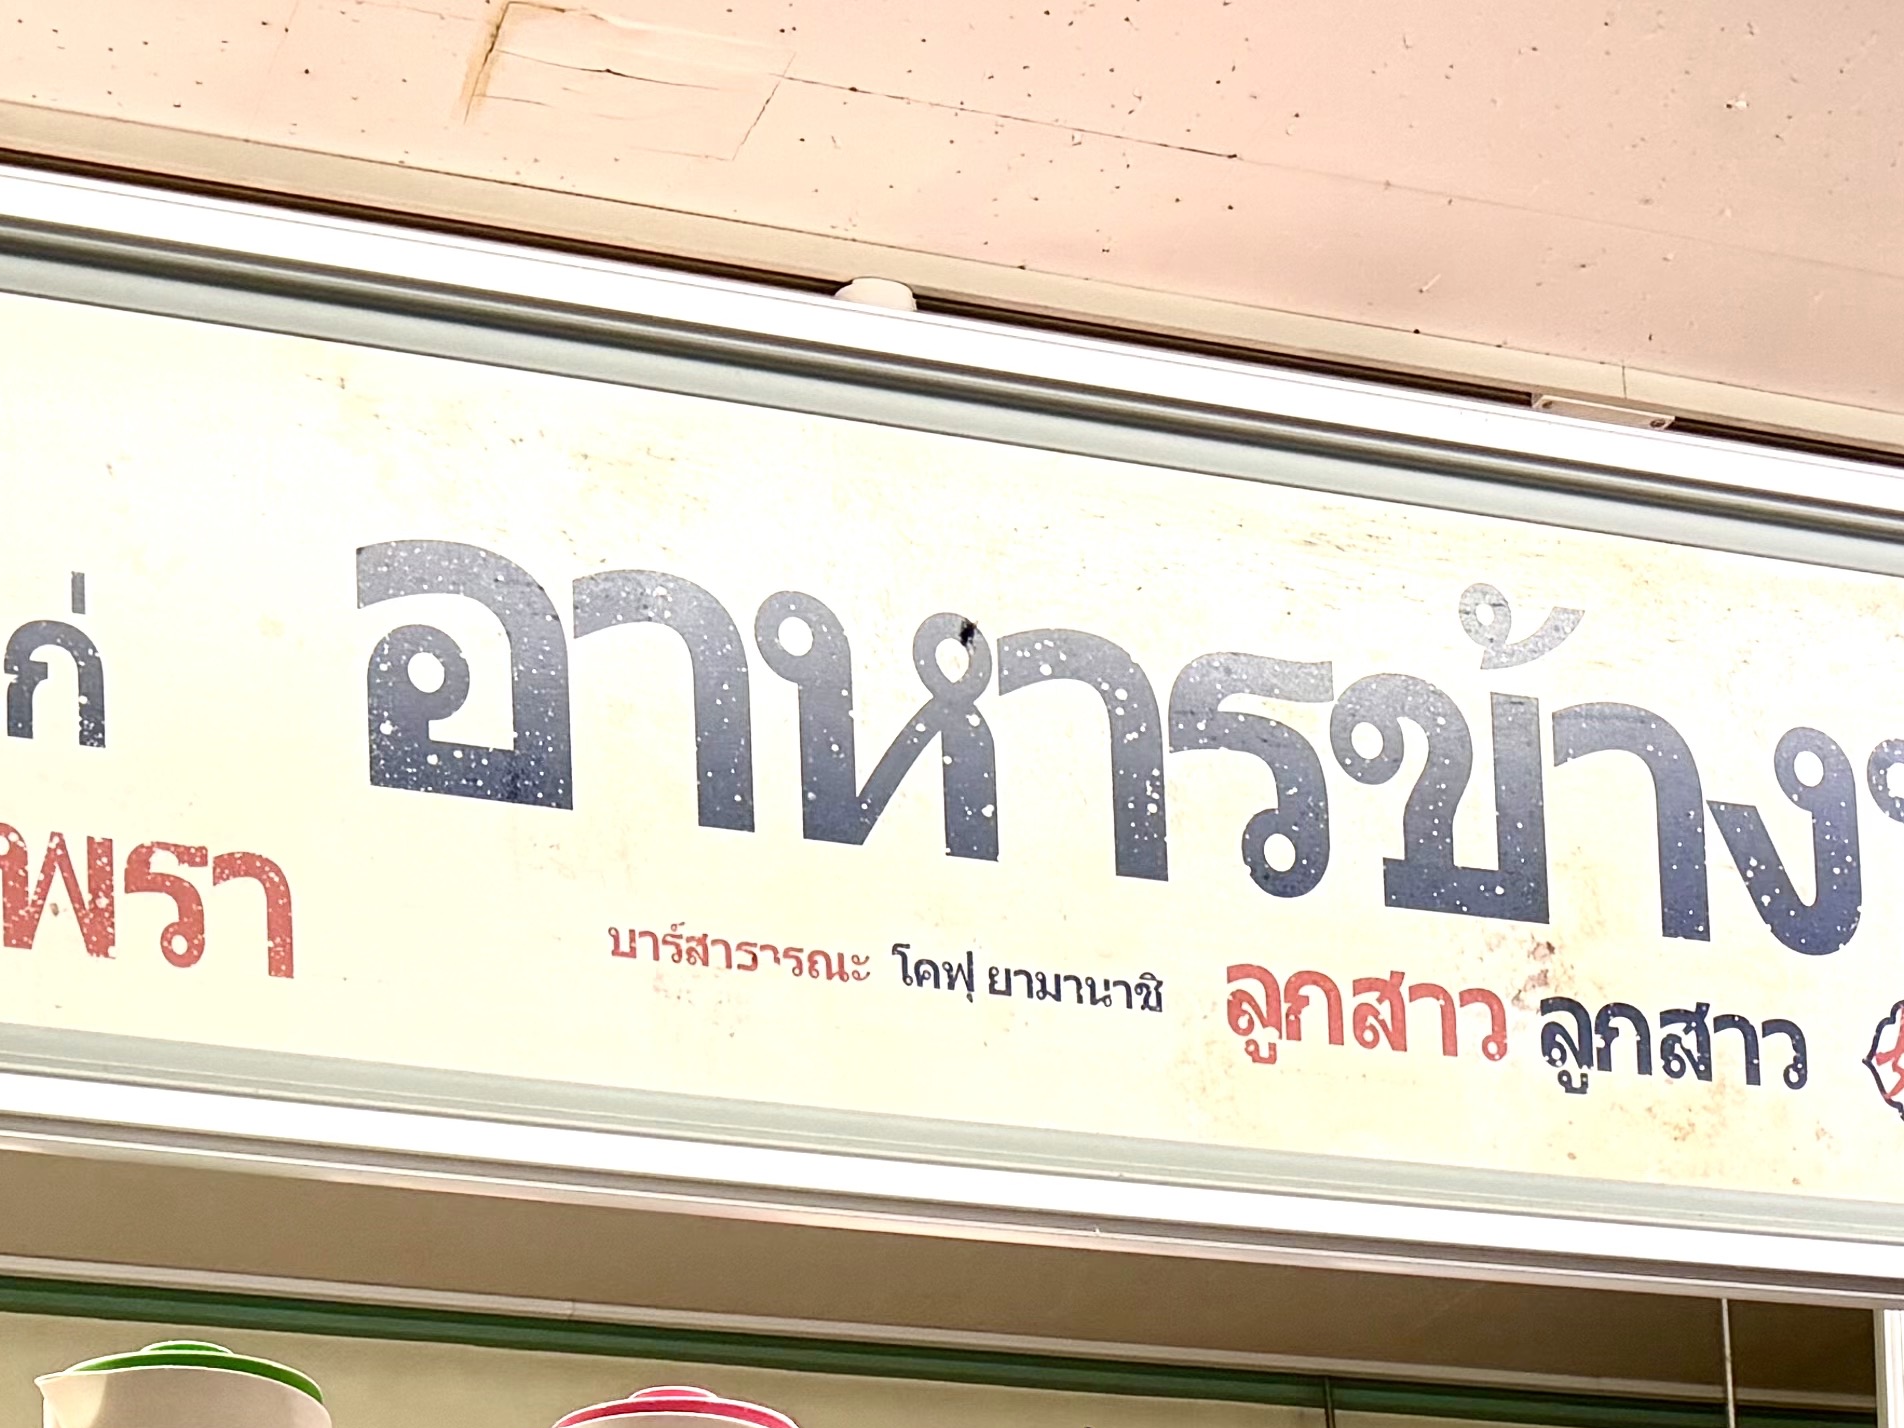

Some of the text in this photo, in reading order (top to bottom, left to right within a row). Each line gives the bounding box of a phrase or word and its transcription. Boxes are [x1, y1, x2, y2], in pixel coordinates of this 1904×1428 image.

[1226, 964, 1807, 1095] ลูกสาว ลูกสาว
